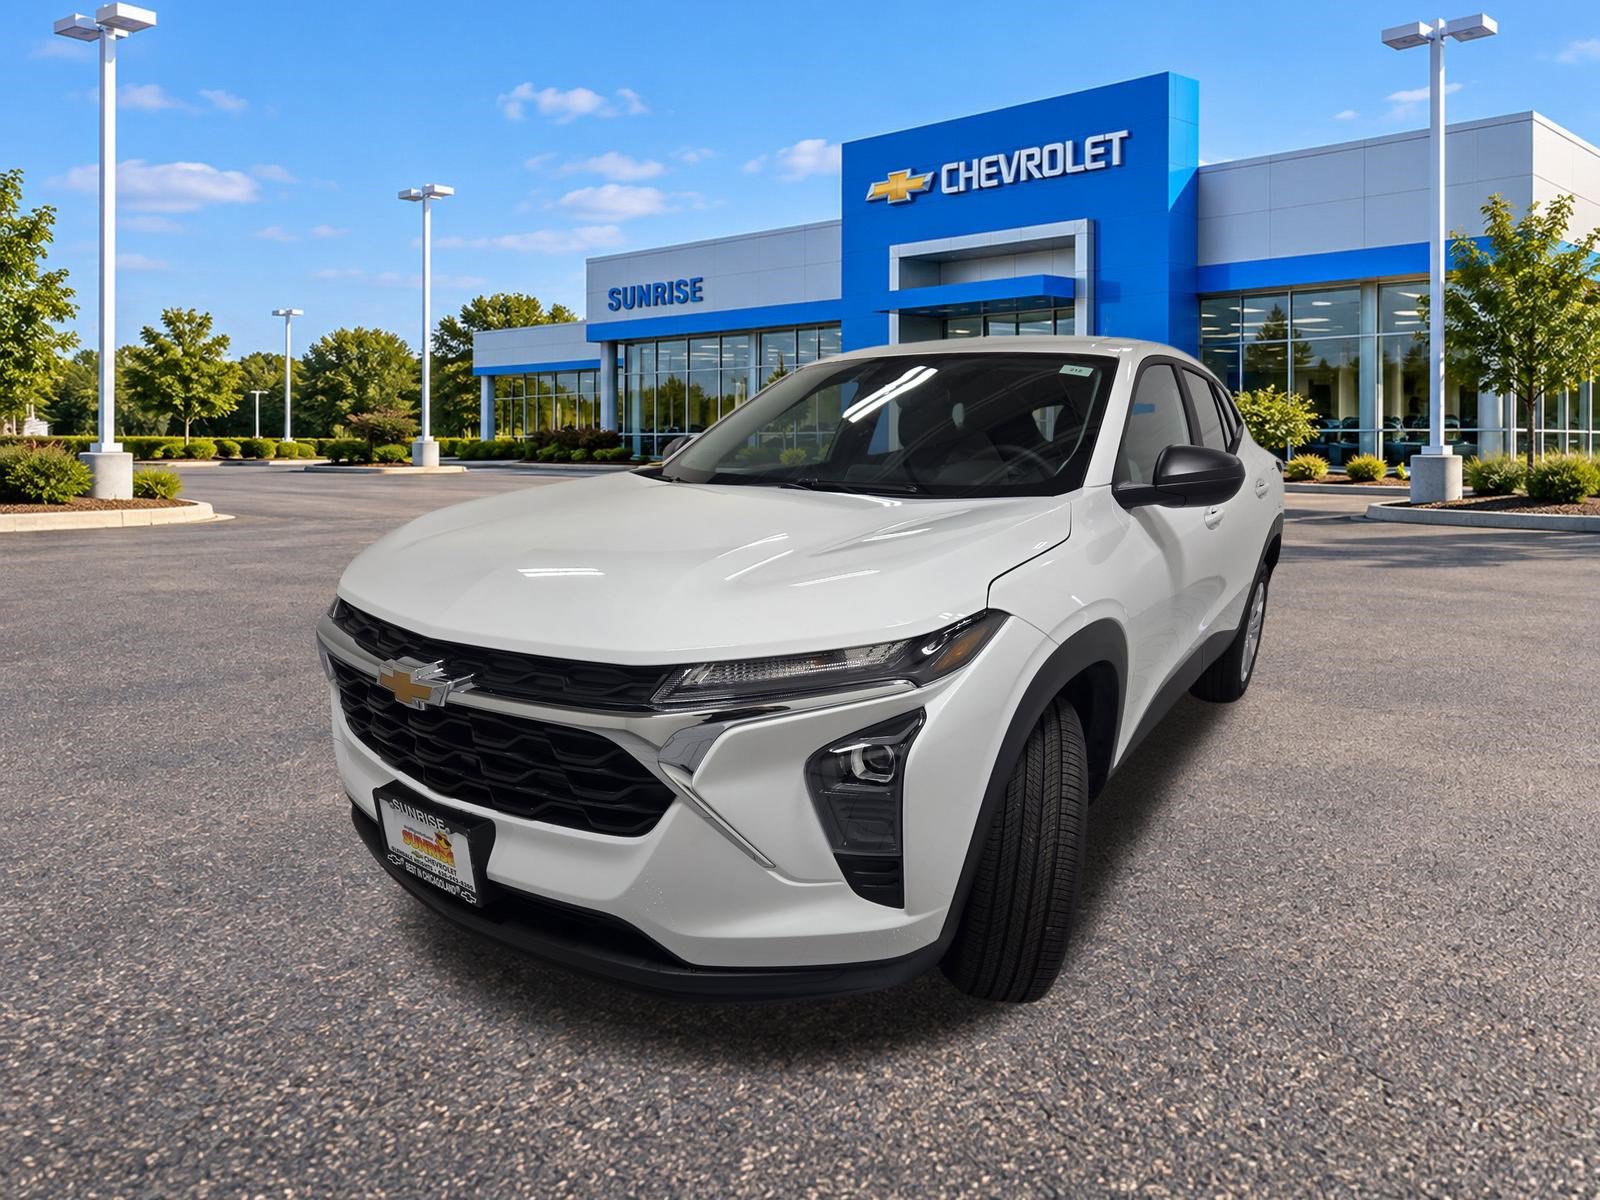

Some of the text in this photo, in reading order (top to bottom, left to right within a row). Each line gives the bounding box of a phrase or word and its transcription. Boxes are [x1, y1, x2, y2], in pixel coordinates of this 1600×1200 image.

[940, 130, 1129, 195] CHEVROLET
[607, 277, 704, 311] SUNRISE
[391, 798, 445, 830] SUNRISE
[424, 856, 457, 876] CHEVROLET
